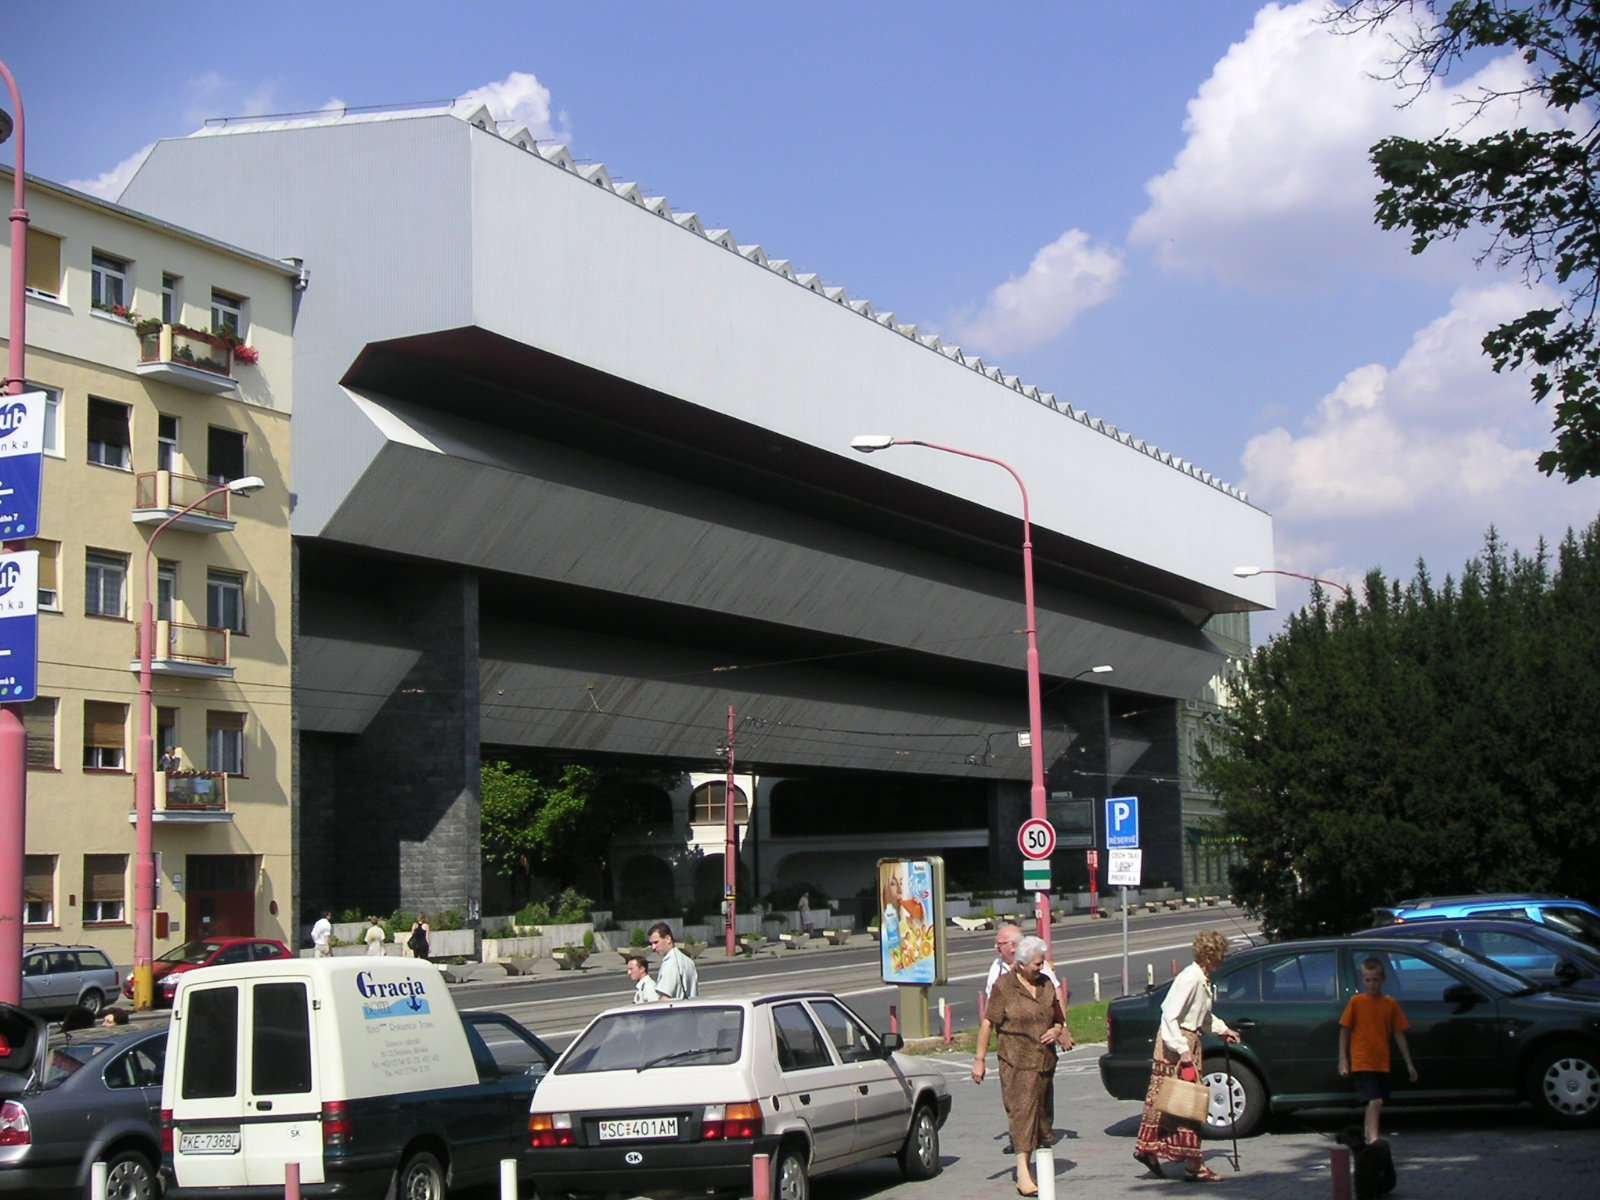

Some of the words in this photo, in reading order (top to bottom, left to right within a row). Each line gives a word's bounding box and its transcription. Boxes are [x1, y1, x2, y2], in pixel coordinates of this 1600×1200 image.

[1113, 802, 1130, 832] P
[1028, 830, 1046, 849] 50
[356, 971, 426, 999] Gracia
[627, 1153, 640, 1162] SK
